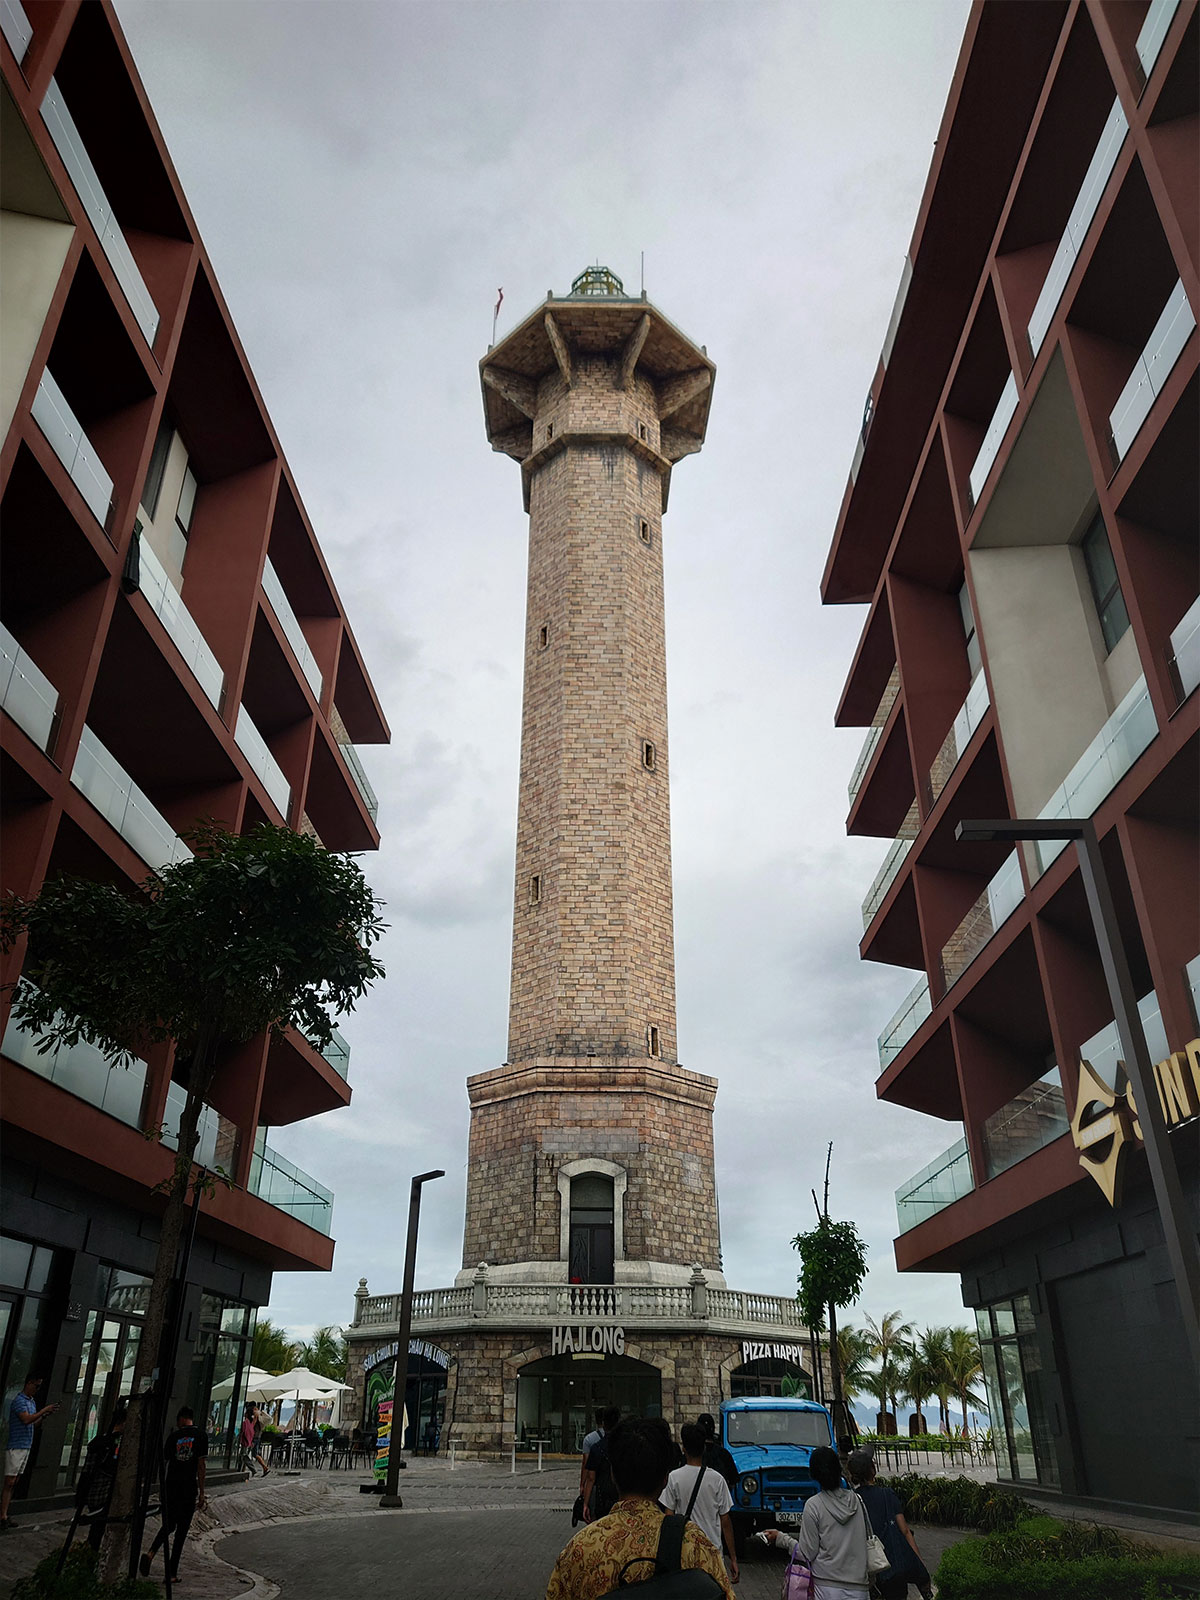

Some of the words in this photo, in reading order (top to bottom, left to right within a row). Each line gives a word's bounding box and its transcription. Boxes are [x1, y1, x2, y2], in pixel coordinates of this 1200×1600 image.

[551, 1326, 625, 1356] HAJLONG
[742, 1341, 771, 1364] PIZZA
[773, 1343, 803, 1368] HAPPY
[432, 1347, 448, 1370] LONG
